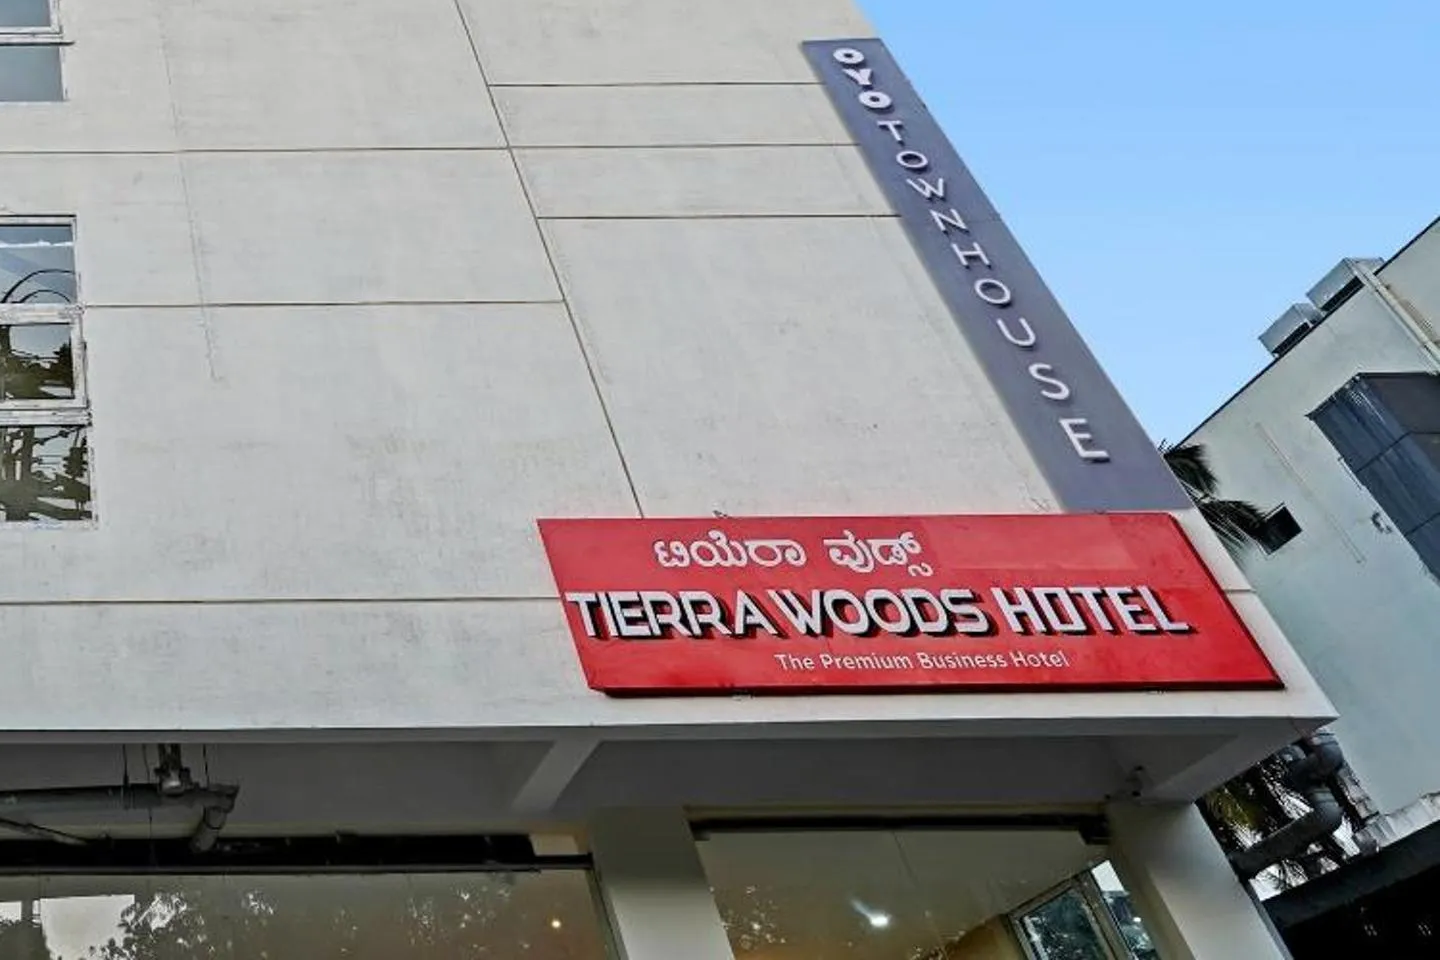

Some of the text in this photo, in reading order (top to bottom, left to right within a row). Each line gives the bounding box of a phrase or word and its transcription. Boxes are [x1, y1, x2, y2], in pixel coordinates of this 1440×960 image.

[833, 47, 1110, 462] OYO TOWNHOUSE
[566, 585, 1190, 638] TIERRA WOODS HOTEL
[774, 649, 1071, 671] The Premium Business Hotel
